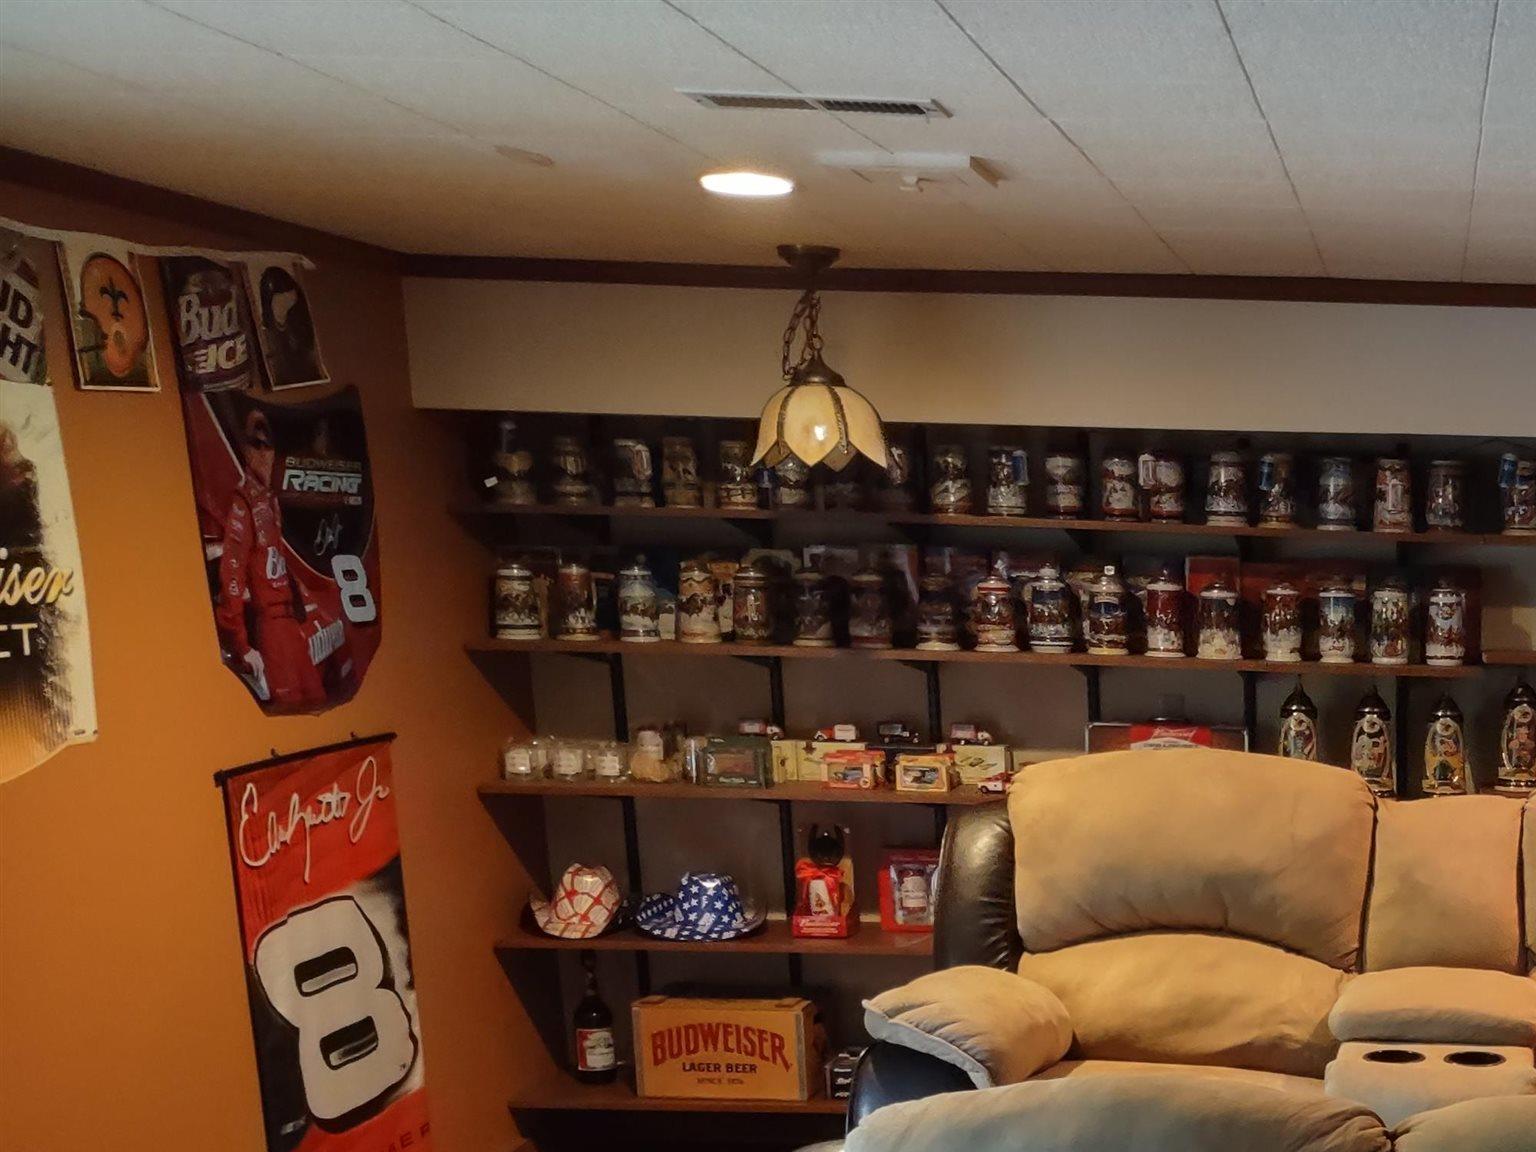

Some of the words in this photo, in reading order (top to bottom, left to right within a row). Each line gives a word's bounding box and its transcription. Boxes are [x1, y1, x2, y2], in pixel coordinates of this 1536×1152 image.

[178, 286, 239, 347] Bud
[193, 335, 248, 374] ICE
[283, 468, 363, 493] RACING
[331, 555, 377, 623] 8
[255, 896, 417, 1124] 8
[651, 1022, 793, 1072] BUDWEISER
[682, 1062, 721, 1073] LAGER
[726, 1063, 757, 1074] BEER
